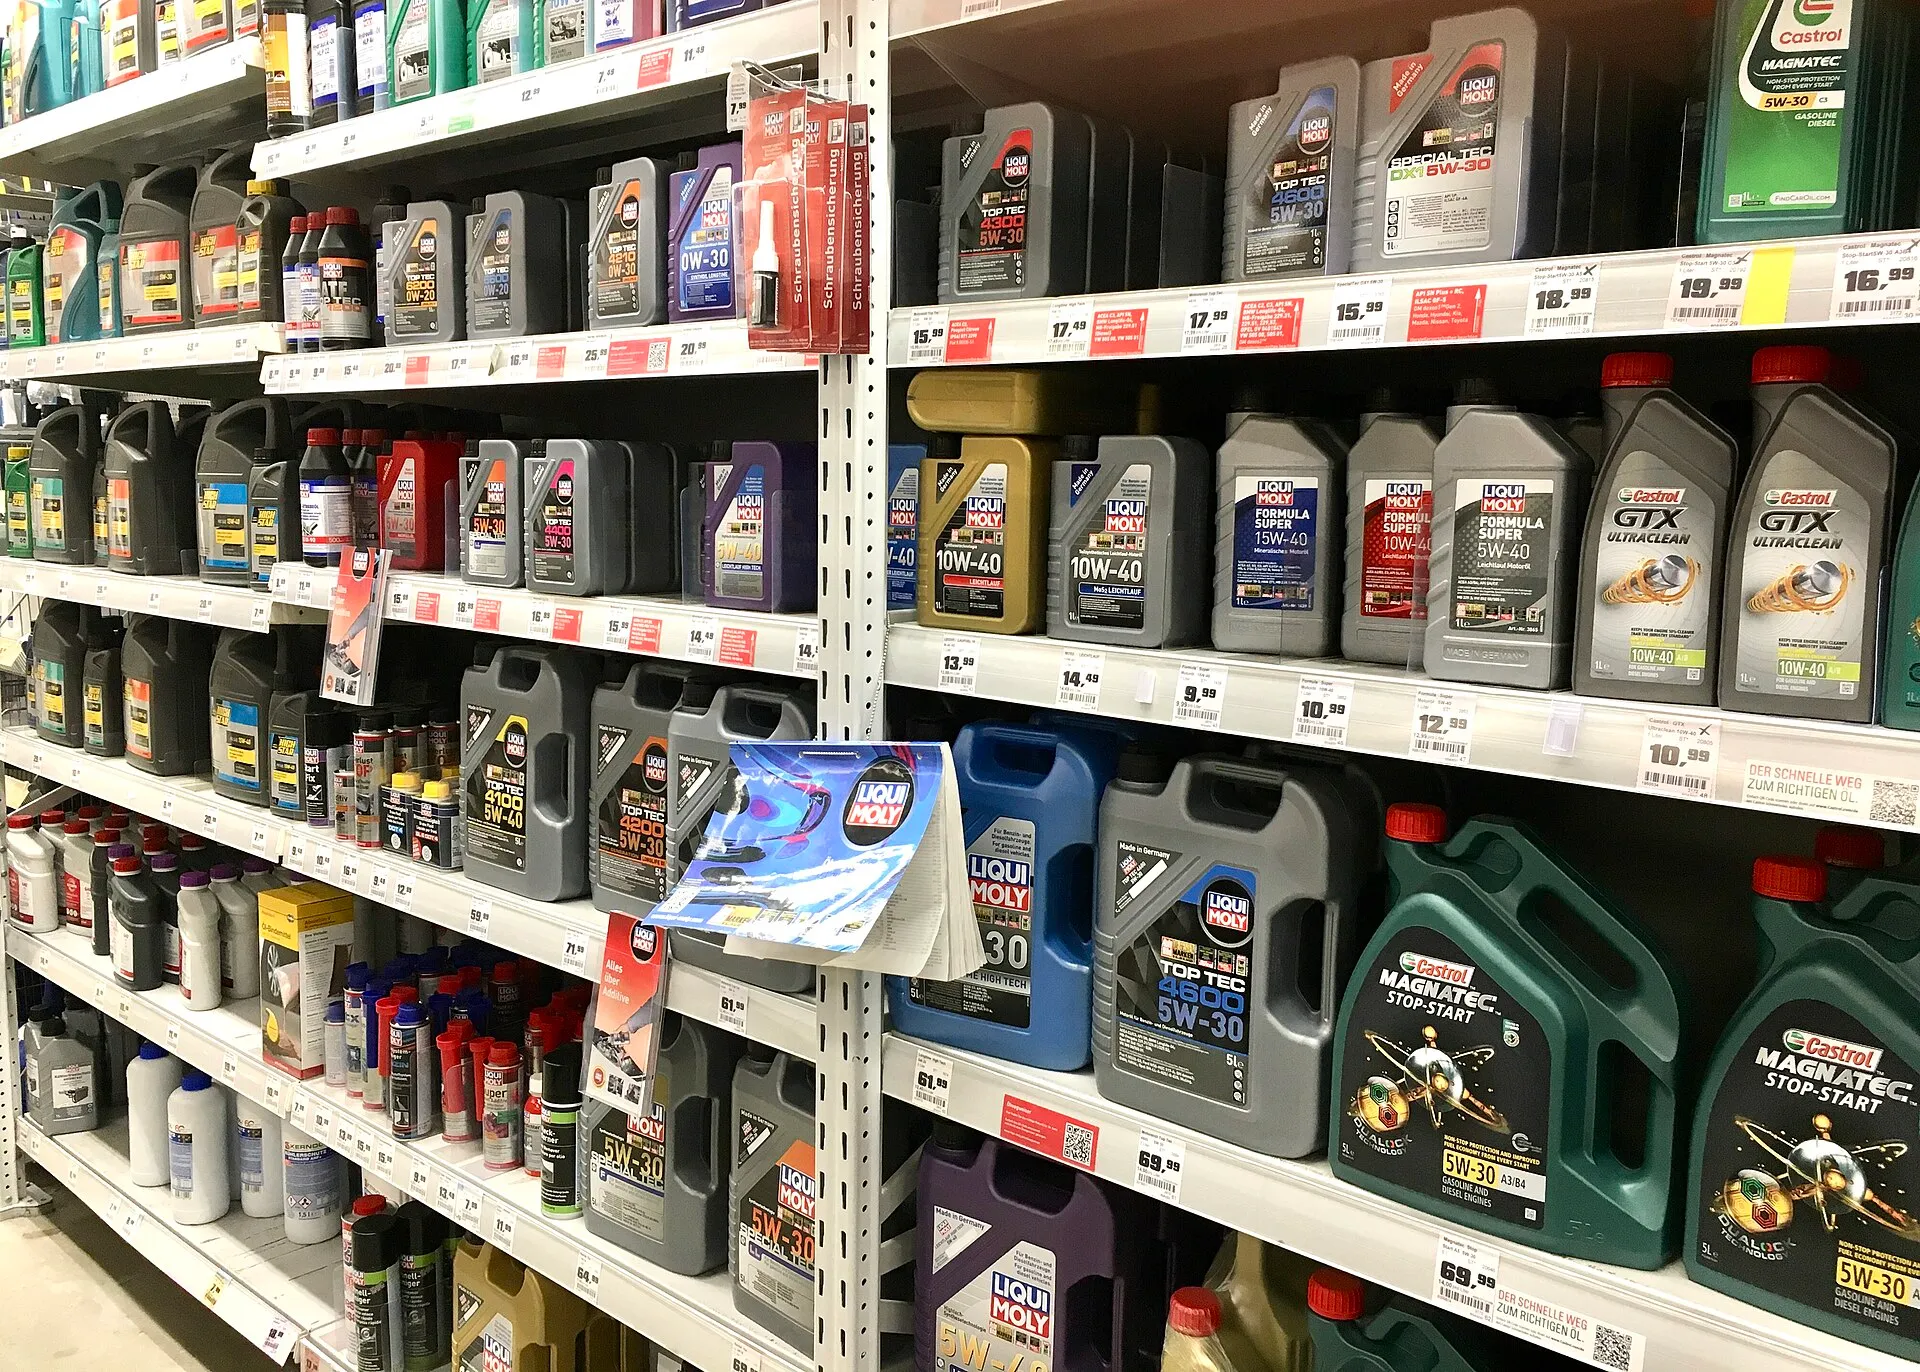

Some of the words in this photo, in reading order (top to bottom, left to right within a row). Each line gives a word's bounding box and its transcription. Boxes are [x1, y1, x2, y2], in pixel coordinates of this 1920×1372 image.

[1762, 56, 1841, 71] MAGNATEC
[1766, 77, 1799, 85] NON-STOP
[1800, 75, 1840, 83] PROTECTION
[731, 102, 747, 115] 7,99
[1795, 112, 1837, 120] GASOLINE
[765, 125, 783, 137] MOLY
[1302, 118, 1328, 132] LIQUI
[1391, 150, 1457, 168] SPECIAL
[1459, 146, 1493, 159] TEC
[1006, 165, 1028, 177] MOLY
[1390, 165, 1423, 182] DX1
[1426, 158, 1491, 177] 5W-30
[1273, 181, 1299, 191] TOP
[1300, 174, 1326, 185] TEC
[1271, 187, 1325, 204] 4600
[703, 201, 728, 212] LIQUI
[981, 208, 1003, 218] TOP
[1004, 205, 1026, 214] TEC
[703, 213, 728, 227] MOLY
[823, 148, 840, 309] Schraubensicherung
[980, 214, 1024, 230] 4300
[852, 151, 862, 311] Schraubensicherung
[608, 252, 636, 263] 4210
[681, 249, 728, 272] 0W-30
[1680, 277, 1743, 299] 19,99
[1843, 267, 1915, 292] 16,99
[1535, 287, 1592, 310] 18,99
[1190, 310, 1228, 330] 17,99
[1336, 301, 1384, 322] 15,99
[913, 328, 944, 345] 15,99
[1053, 320, 1087, 338] 17,49
[1258, 482, 1293, 494] LIQUI
[1386, 484, 1422, 496] LIQUI
[1484, 485, 1525, 499] LIQUI
[1633, 490, 1680, 503] Castrol
[738, 495, 761, 507] LIQUI
[891, 498, 915, 512] LIQUI
[1257, 493, 1294, 506] MOLY
[1385, 495, 1422, 508] MOLY
[1780, 491, 1831, 505] Castrol
[738, 506, 761, 520] MOLY
[891, 512, 916, 526] MOLY
[1255, 508, 1310, 520] FORMULA
[1612, 506, 1688, 531] GTX
[1758, 509, 1840, 535] GTX
[544, 526, 571, 535] 4400
[1254, 518, 1293, 530] SUPER
[1383, 523, 1421, 534] SUPER
[1479, 516, 1545, 530] FORMULA
[544, 536, 571, 549] 5W-30
[1254, 532, 1307, 546] 15W-40
[1478, 528, 1523, 541] SUPER
[1606, 531, 1690, 545] ULTRACLEAN
[1751, 535, 1843, 550] ULTRACLEAN
[1477, 544, 1530, 560] 5W-40
[936, 551, 1002, 574] 10W-40
[1070, 556, 1142, 582] 10W-40
[1477, 561, 1506, 569] Leichtlauf
[1507, 562, 1531, 570] Motoröl
[969, 579, 1001, 587] LEICHTLAUF
[1108, 587, 1142, 596] LEICHTLAUF
[690, 630, 714, 643] 14,49
[943, 655, 974, 671] 13,99
[1447, 647, 1471, 659] MADE
[1472, 650, 1481, 659] IN
[1482, 650, 1526, 661] GERMANY
[1631, 648, 1674, 664] 10W-40
[1063, 670, 1099, 688] 14,49
[1184, 685, 1217, 704] 9,99
[1301, 700, 1346, 720] 10,99
[1419, 714, 1468, 735] 12,99
[647, 755, 666, 769] LIQUI
[1650, 743, 1710, 768] 10,99
[1749, 763, 1771, 777] DER
[1773, 766, 1834, 786] SCHNELLE
[1835, 774, 1863, 789] WEG
[486, 779, 505, 792] TOP
[505, 784, 524, 797] TEC
[857, 782, 909, 805] LIQUI
[484, 790, 523, 811] 4100
[484, 803, 523, 829] 5W-40
[621, 804, 642, 817] TOP
[644, 808, 665, 823] TEC
[848, 803, 906, 827] MOLY
[620, 816, 665, 838] 4200
[1119, 842, 1136, 852] Made
[1143, 847, 1171, 860] Germany
[971, 881, 1028, 909] MOLY
[634, 927, 655, 941] LIQUI
[605, 958, 623, 974] Alles
[1416, 958, 1470, 985] Castrol
[604, 972, 620, 987] über
[980, 972, 1001, 987] HIGH
[1003, 977, 1027, 990] TECH
[1160, 960, 1201, 982] TOP
[1203, 970, 1246, 993] TEC
[602, 987, 630, 1005] Additive
[1158, 976, 1245, 1015] 4600
[1379, 968, 1498, 1014] MAGNATEC
[721, 996, 745, 1013] 61,99
[1385, 990, 1475, 1025] STOP-START
[1158, 996, 1244, 1042] 5W-30
[1805, 1037, 1874, 1070] Castrol
[918, 1071, 948, 1091] 61,99
[1755, 1046, 1913, 1104] MAGNATEC
[1764, 1072, 1883, 1115] STOP-START
[604, 1136, 663, 1181] 5W-30
[1138, 1149, 1180, 1174] 69,99
[1446, 1153, 1496, 1185] 5W-30
[1500, 1174, 1526, 1190] A3/B4
[1441, 1185, 1463, 1200] DIESEL
[1463, 1193, 1492, 1208] ENGINES
[936, 1207, 952, 1219] Made
[952, 1213, 958, 1221] in
[958, 1214, 985, 1231] Germany
[752, 1206, 815, 1265] 5W-30
[1837, 1247, 1854, 1257] FUEL
[1854, 1252, 1887, 1268] ECONOMY
[1887, 1262, 1907, 1273] FROM
[1907, 1266, 1920, 1277] EVE
[1440, 1260, 1496, 1290] 69,99
[1840, 1261, 1905, 1300] 5W-30
[993, 1273, 1049, 1313] LIQUI
[1835, 1286, 1876, 1308] GASOLINE
[1876, 1300, 1896, 1314] AND
[993, 1296, 1049, 1336] MOLY
[1498, 1289, 1517, 1305] DER
[1518, 1296, 1565, 1323] SCHNELLE
[1566, 1313, 1588, 1331] WEG
[1834, 1297, 1862, 1314] DIESEL
[1863, 1307, 1899, 1326] ENGINES
[1496, 1302, 1519, 1319] ZUM
[1519, 1311, 1568, 1337] RICHTIGEN
[1569, 1326, 1585, 1343] ÖL.
